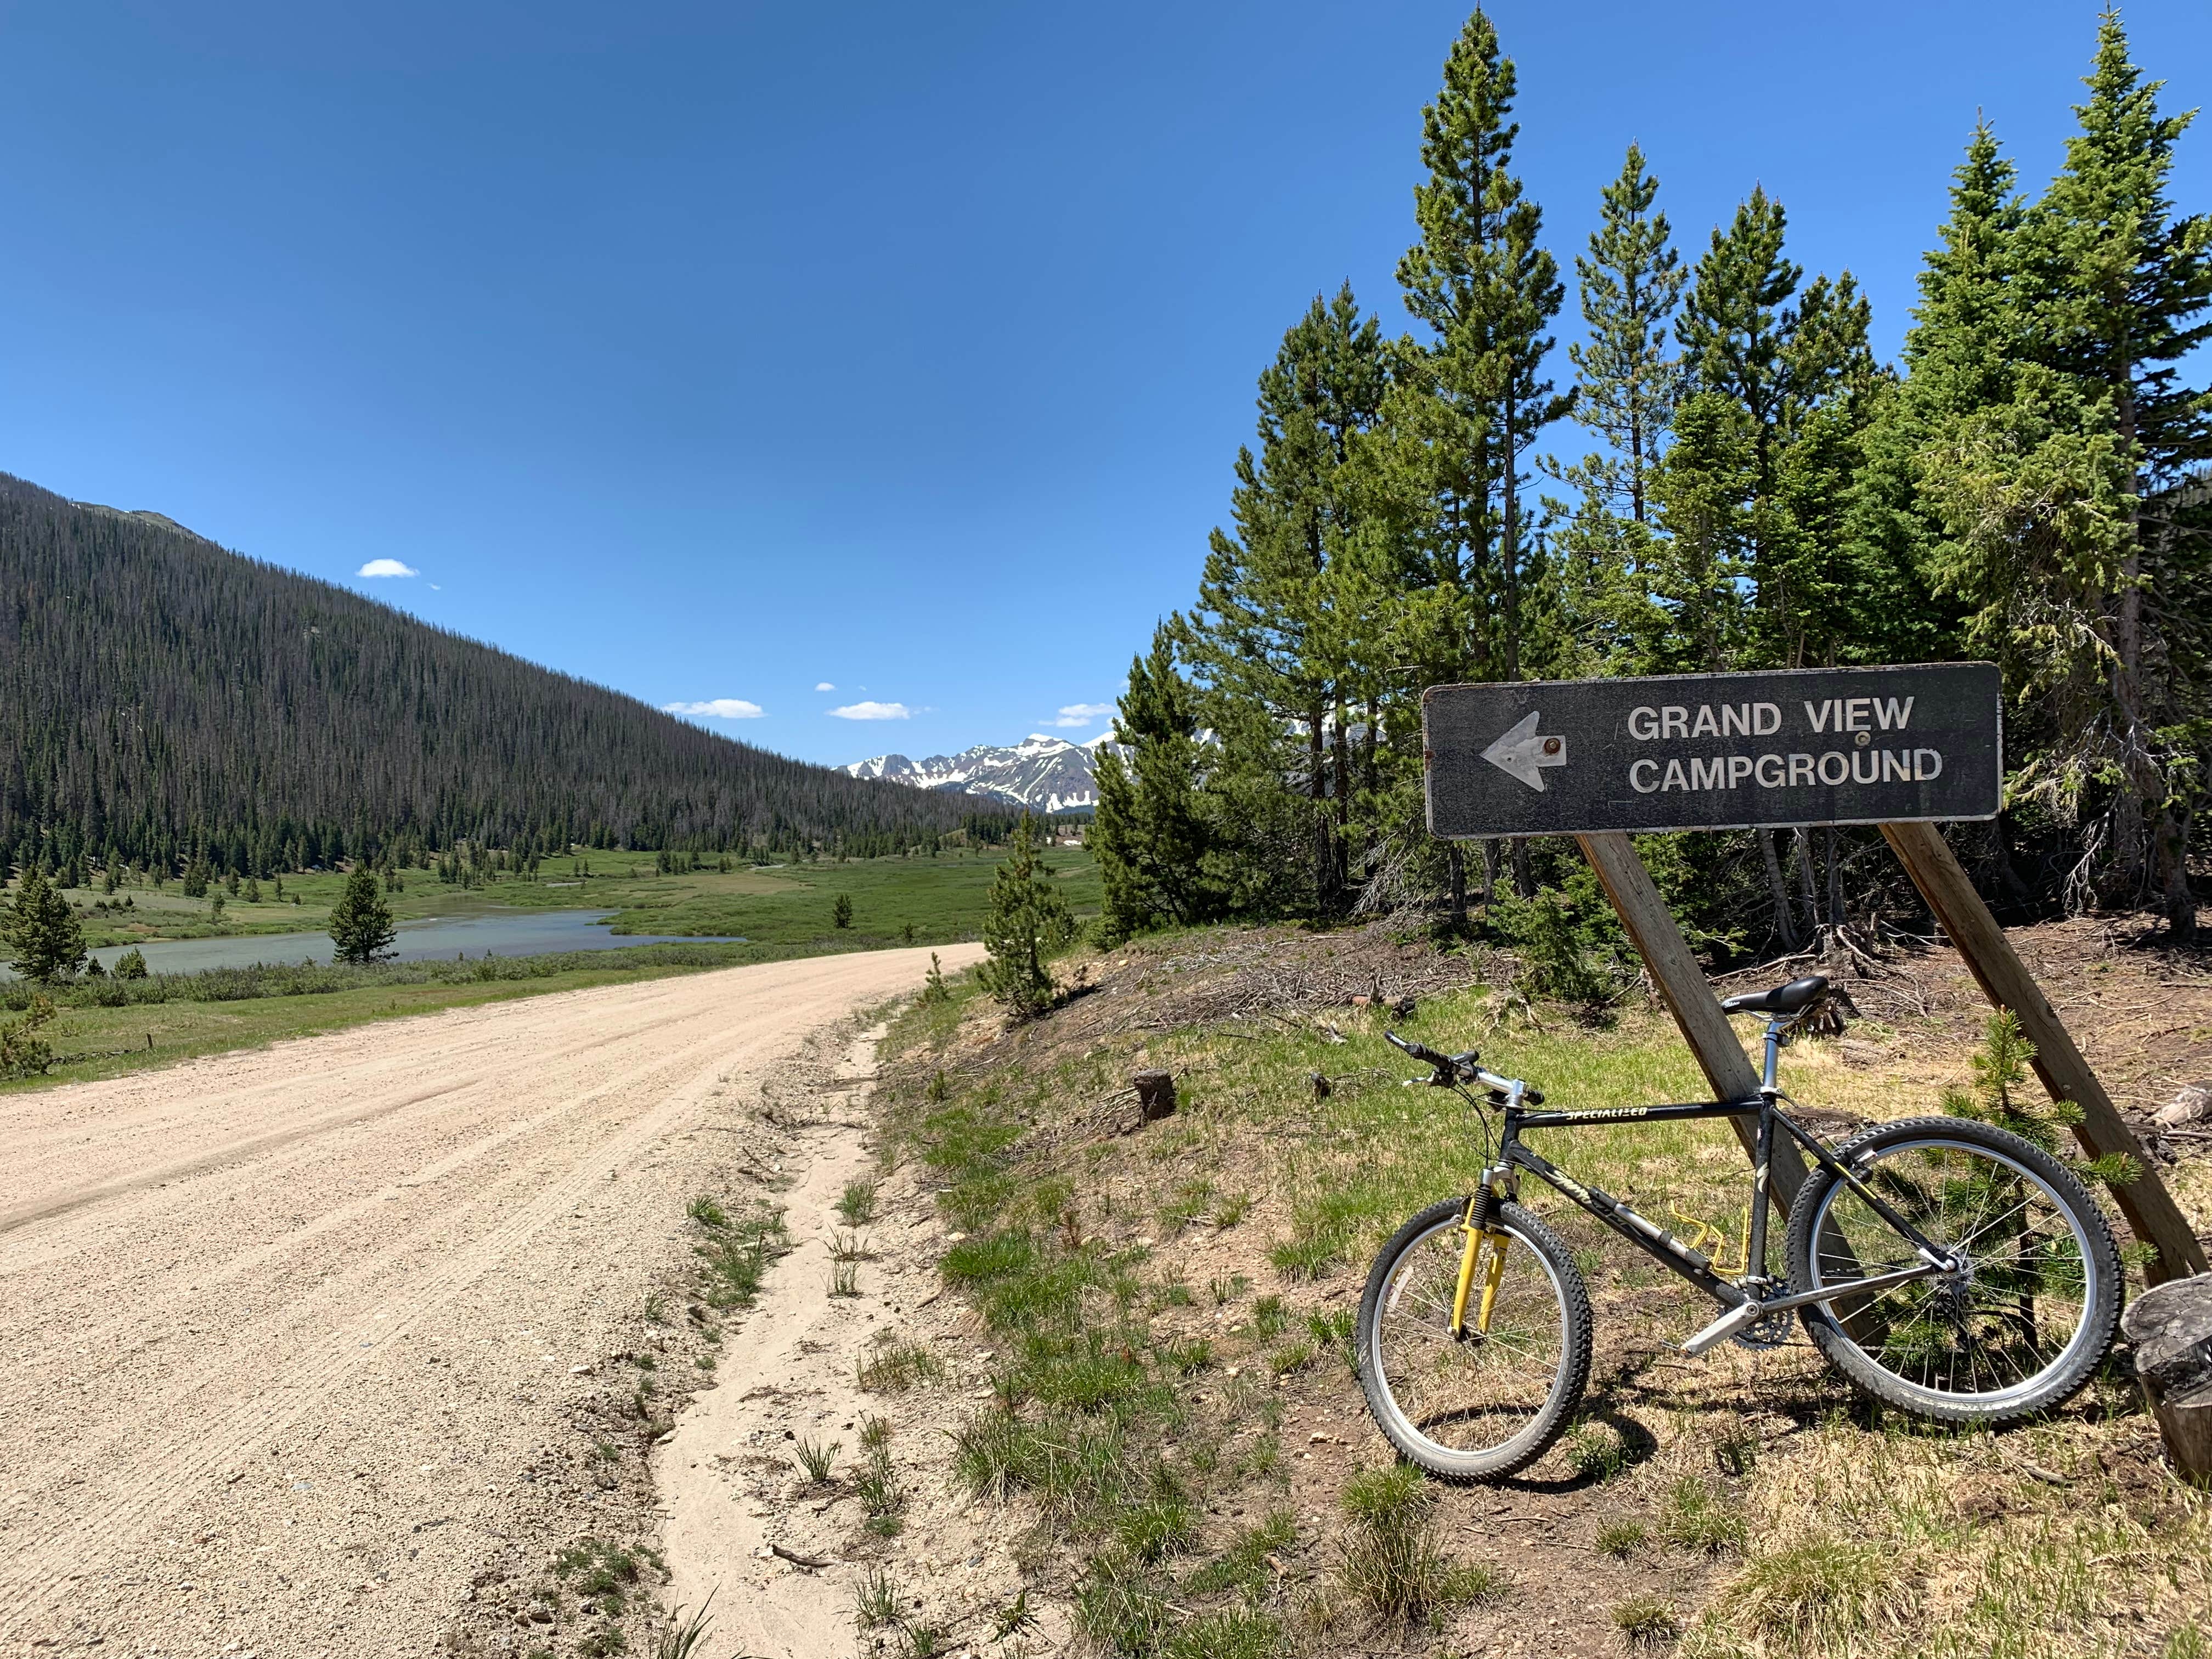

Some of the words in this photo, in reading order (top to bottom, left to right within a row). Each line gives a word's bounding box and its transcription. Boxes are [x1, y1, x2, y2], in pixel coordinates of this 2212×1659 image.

[1627, 702, 1782, 741] GRAND
[1803, 696, 1915, 733] VIEW
[1629, 748, 1943, 793] CAMPGROUND
[1566, 1107, 1648, 1120] SPECIALIZED
